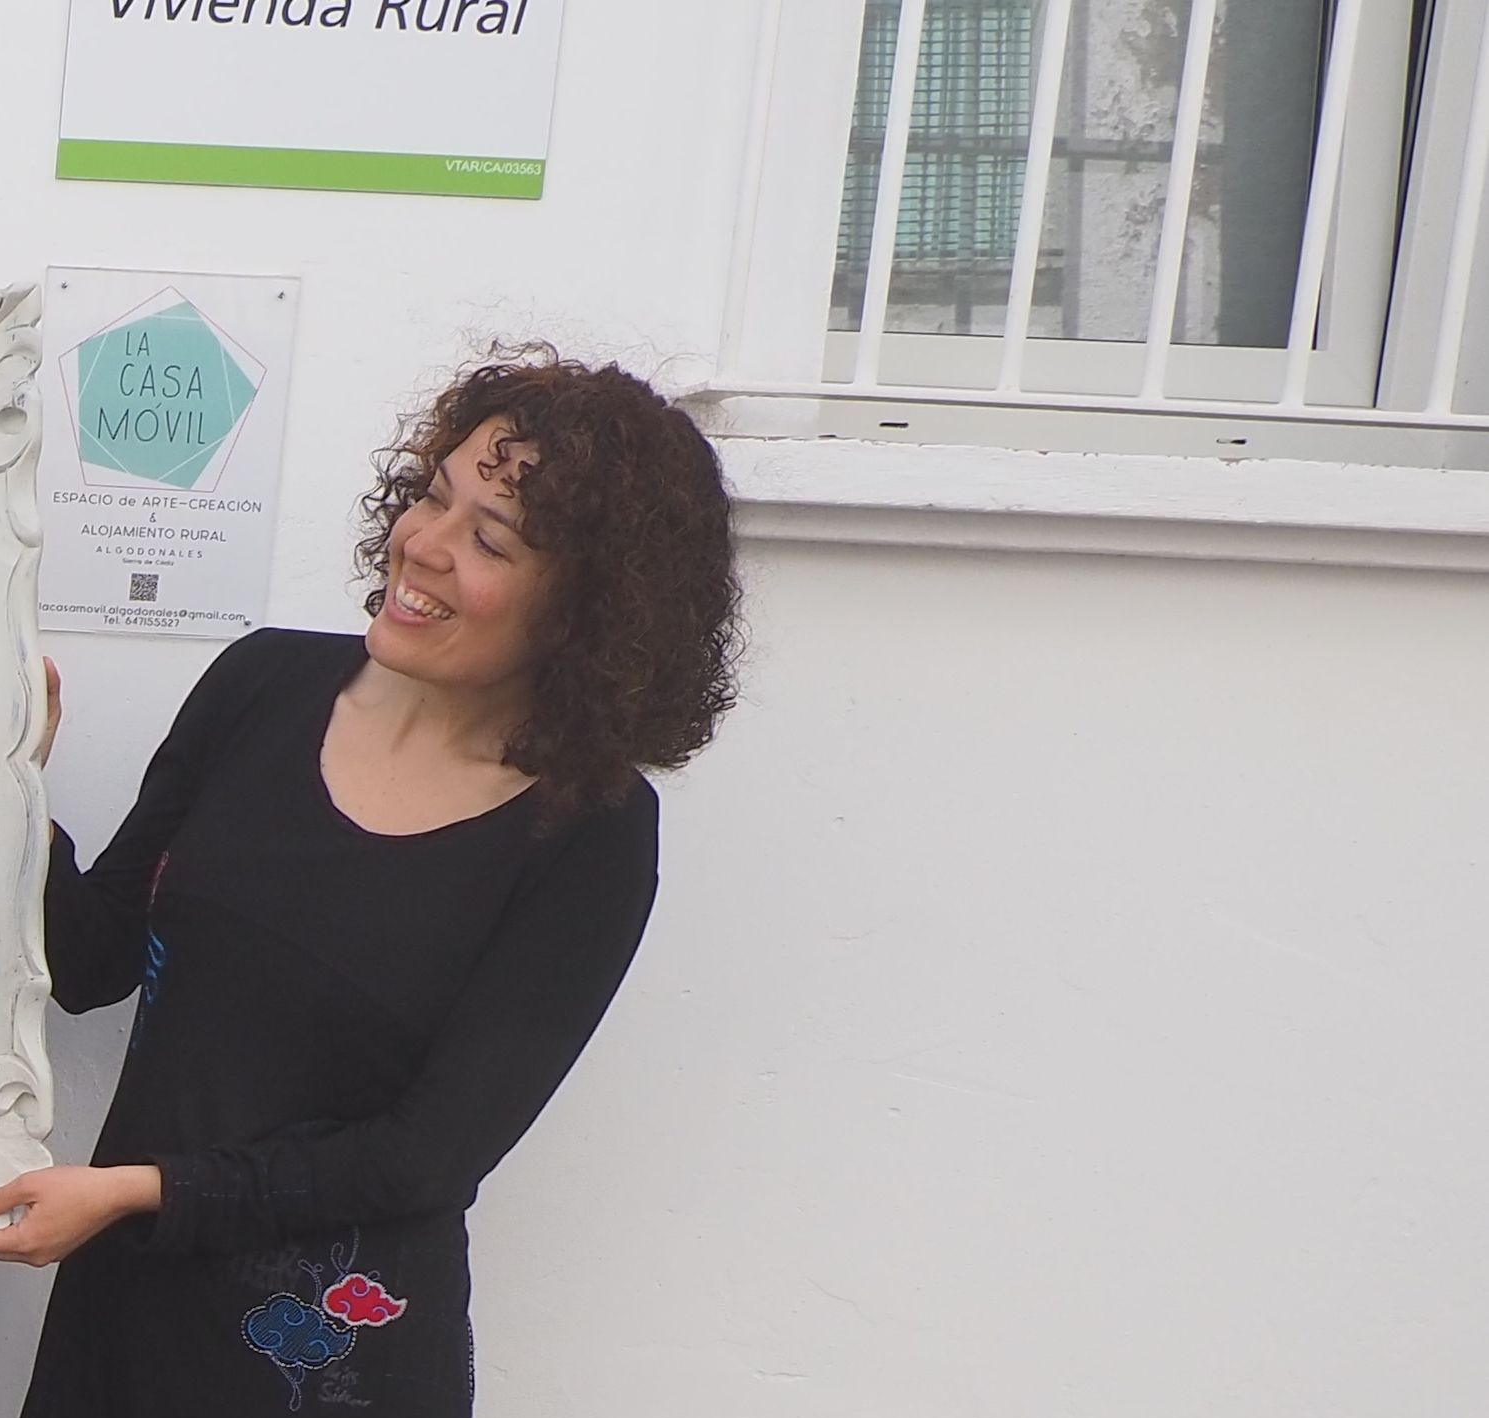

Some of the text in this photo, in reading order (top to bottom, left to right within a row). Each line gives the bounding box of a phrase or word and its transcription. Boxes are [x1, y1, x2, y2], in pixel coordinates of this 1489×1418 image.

[374, 0, 528, 36] Rural
[445, 159, 542, 175] VTAR/CA/03563
[125, 331, 150, 357] LA
[119, 363, 203, 400] CASA
[97, 402, 206, 445] MÓVIL
[52, 491, 113, 506] ESPACIO
[118, 495, 136, 507] de
[81, 524, 227, 543] ALOJAMIENTO RURAL
[95, 545, 203, 559] ALGODONALES
